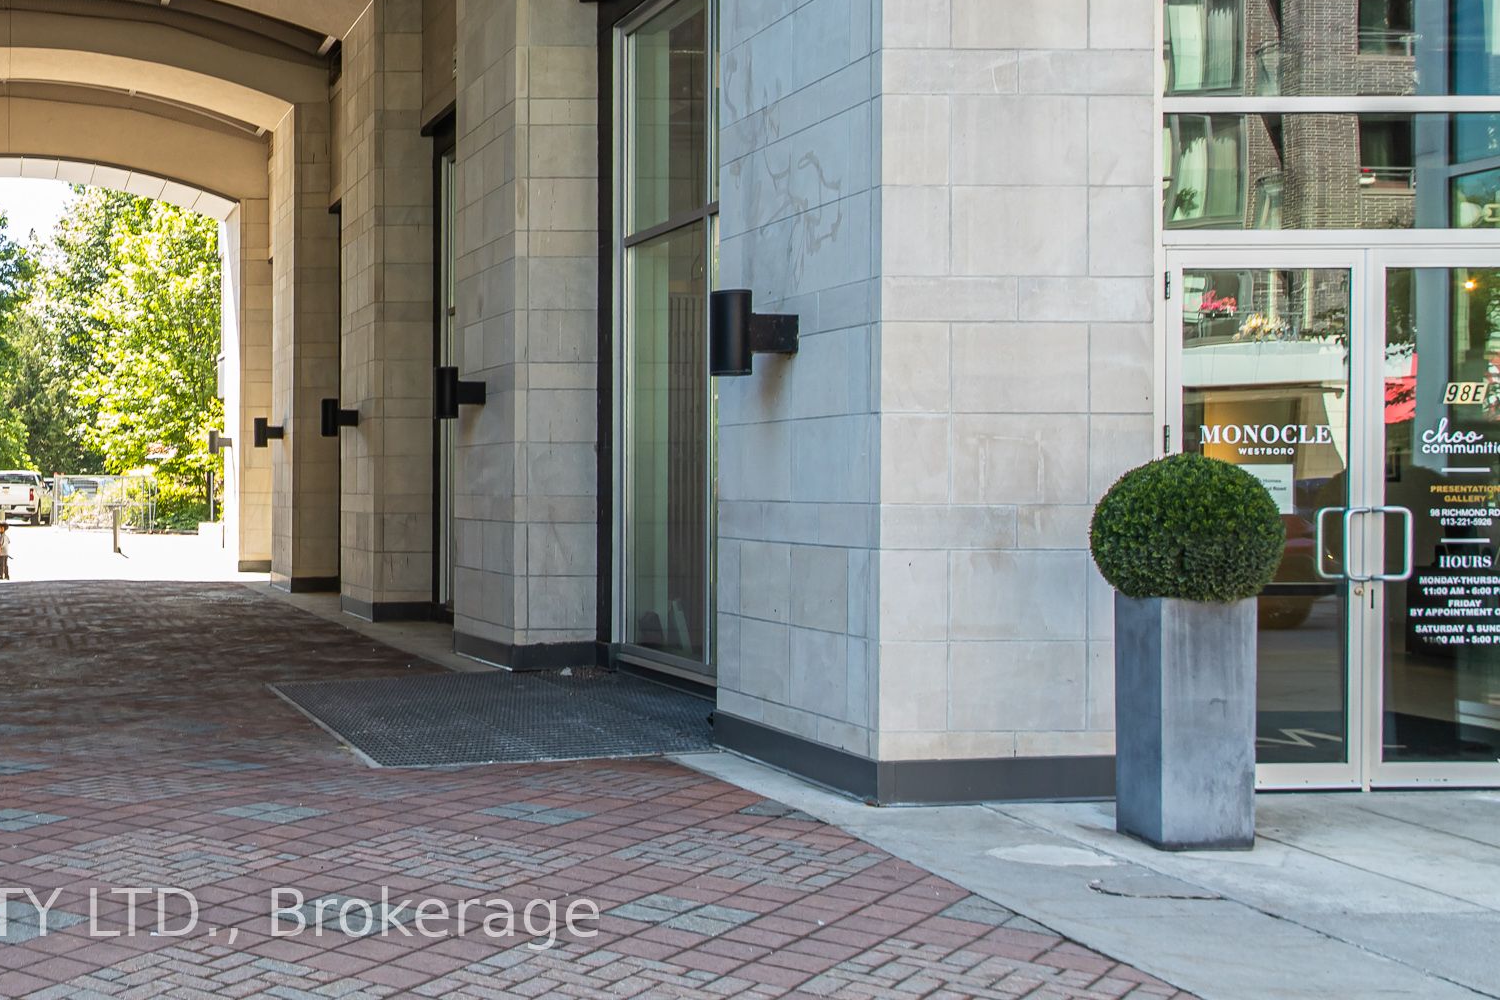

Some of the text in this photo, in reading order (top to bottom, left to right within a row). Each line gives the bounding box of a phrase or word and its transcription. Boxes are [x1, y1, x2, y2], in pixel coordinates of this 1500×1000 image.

[1445, 384, 1485, 402] 98E
[1199, 424, 1332, 444] MONOCLE
[1422, 416, 1484, 443] choo
[1238, 447, 1295, 456] WESTBORO
[1430, 485, 1500, 493] PRESENTATION
[1444, 495, 1486, 503] GALLERY
[1441, 508, 1487, 517] RICHMOND
[1440, 555, 1492, 568] HOURS
[1423, 587, 1448, 595] 11:00
[1449, 587, 1465, 595] AM
[1471, 587, 1492, 595] 6:00
[1493, 587, 1500, 595] P
[1410, 608, 1424, 616] BY
[1425, 608, 1493, 616] APPOINTMENT
[1415, 624, 1465, 633] SATURDAY
[1466, 624, 1475, 633] &
[1423, 635, 1448, 644] 11:00
[1449, 635, 1465, 644] AM
[1471, 635, 1492, 644] 5:00
[1493, 635, 1500, 644] P
